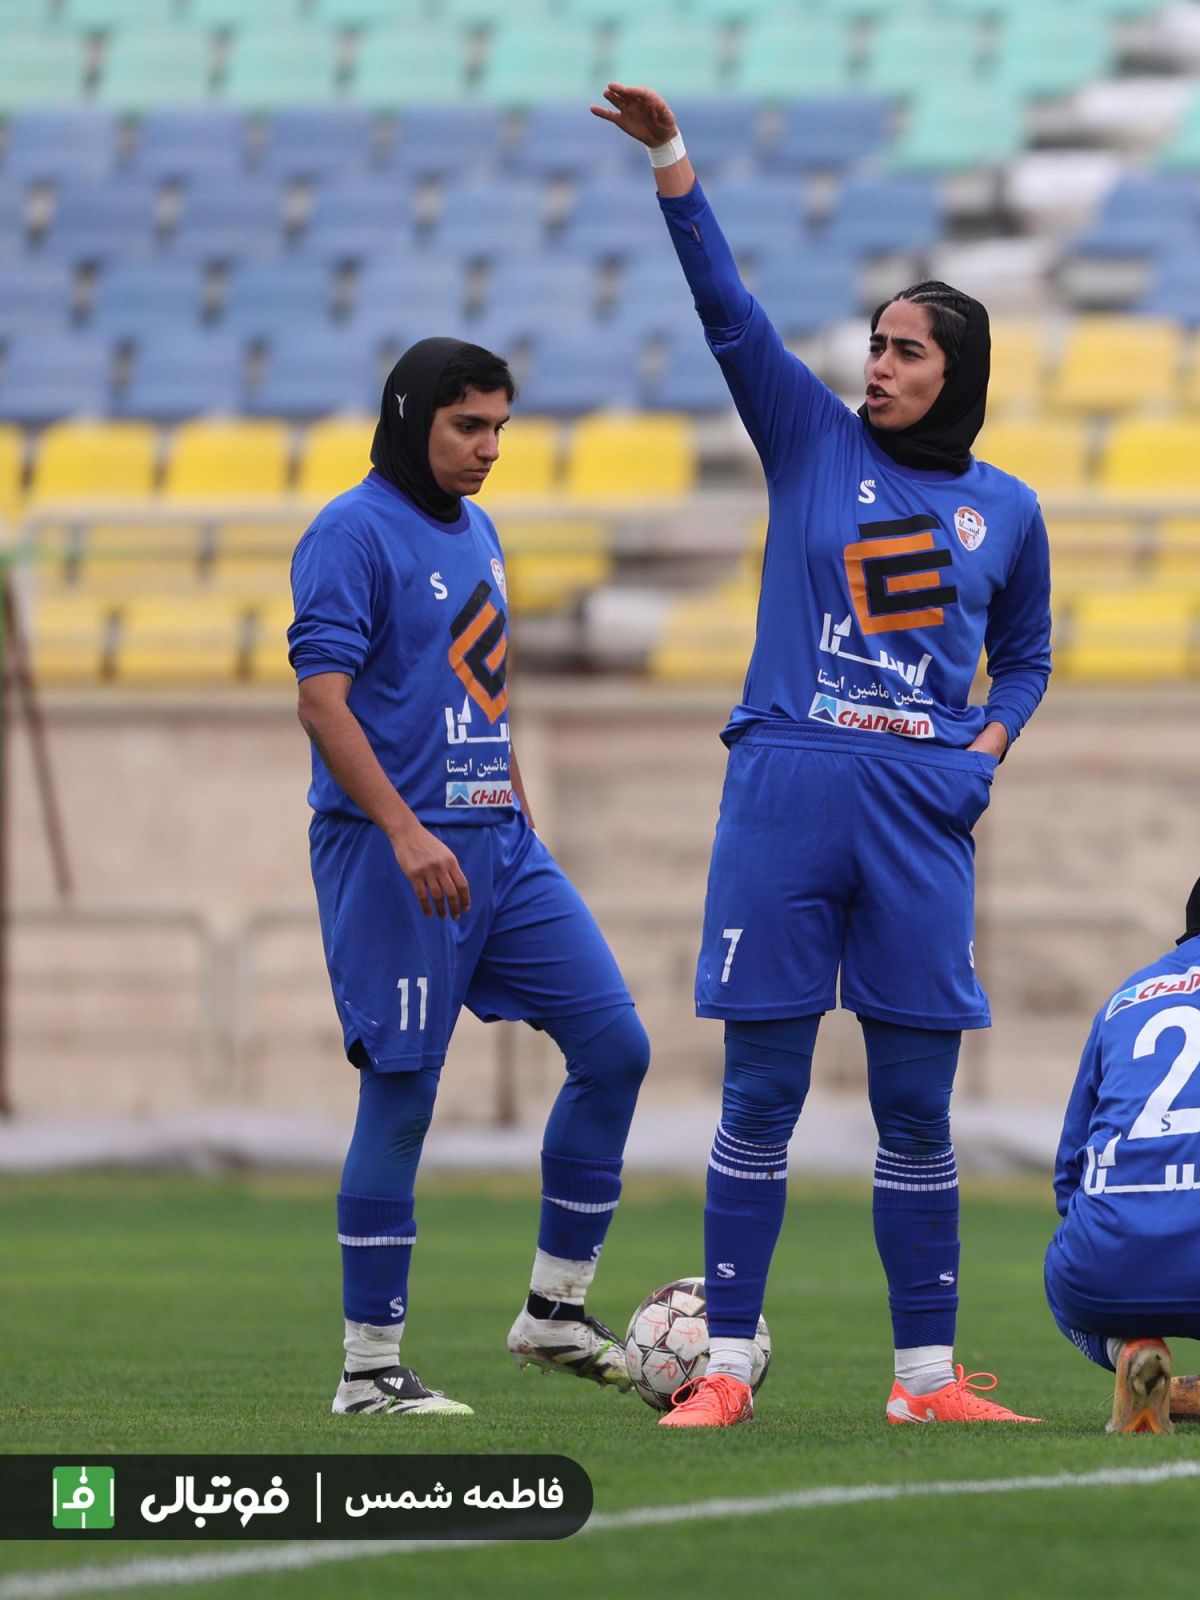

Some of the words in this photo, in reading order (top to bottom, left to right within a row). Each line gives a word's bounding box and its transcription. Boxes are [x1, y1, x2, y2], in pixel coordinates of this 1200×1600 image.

[817, 668, 845, 694] ایستا
[848, 682, 890, 700] ماشین
[893, 687, 934, 706] سنگین
[446, 758, 473, 776] ایستا
[476, 757, 508, 778] ماشین
[720, 928, 744, 983] 7
[396, 976, 428, 1032] 11
